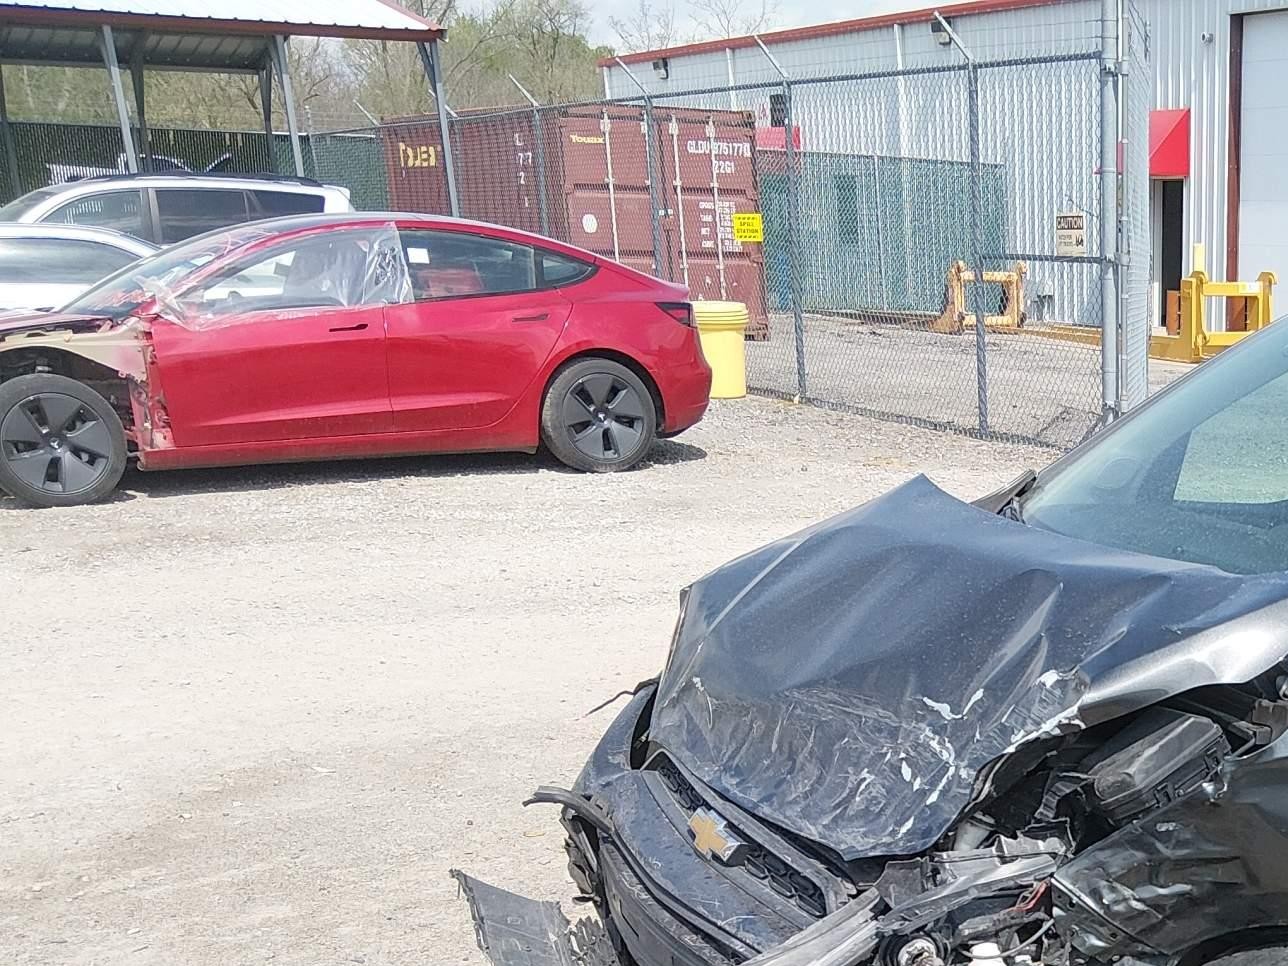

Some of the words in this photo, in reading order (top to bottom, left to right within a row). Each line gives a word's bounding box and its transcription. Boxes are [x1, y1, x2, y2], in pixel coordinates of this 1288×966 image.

[687, 140, 710, 153] GLDU
[714, 161, 734, 173] 22G1
[1056, 217, 1083, 229] CAUTION
